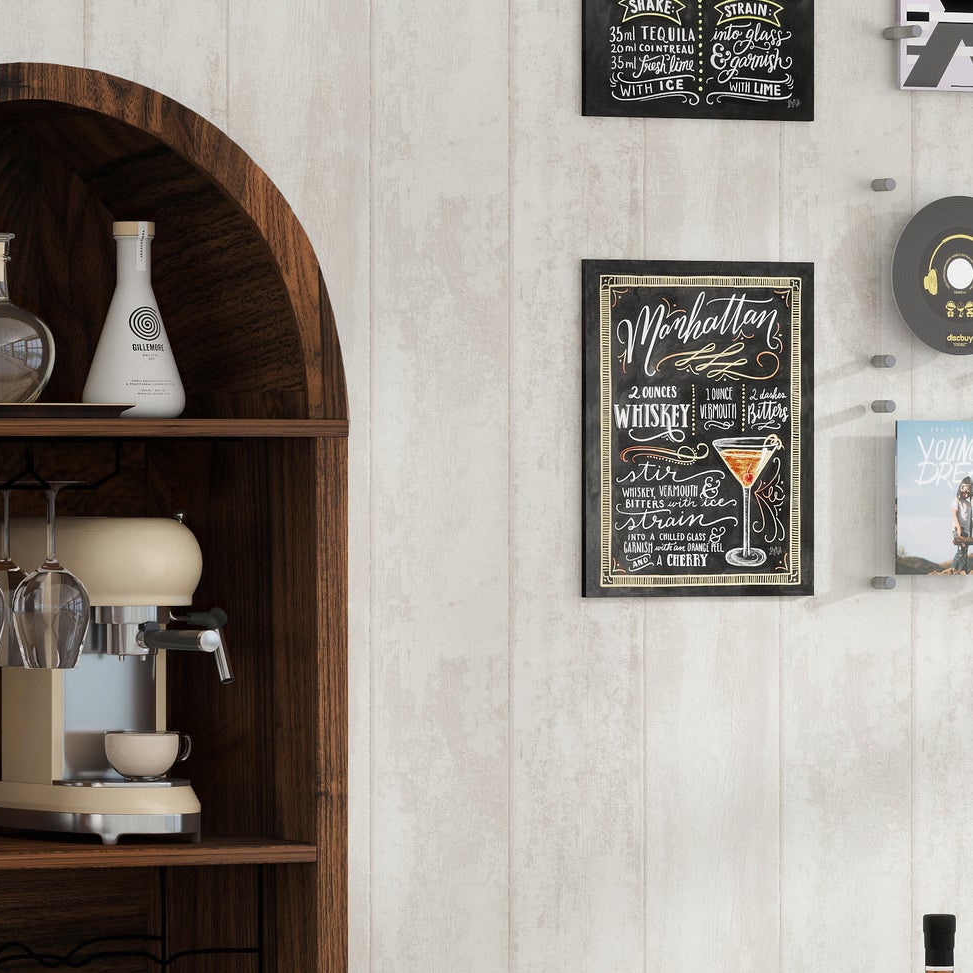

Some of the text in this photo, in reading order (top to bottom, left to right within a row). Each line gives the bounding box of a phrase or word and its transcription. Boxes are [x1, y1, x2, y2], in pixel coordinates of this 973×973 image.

[725, 3, 772, 18] STRAIN:
[640, 26, 696, 42] TEQUILA
[710, 22, 792, 47] into glass
[639, 44, 695, 54] COINTREAU
[633, 55, 671, 78] fresh
[670, 57, 695, 74] lime
[730, 49, 793, 83] garnish
[620, 79, 684, 97] WITH ICE
[729, 82, 781, 96] WITH LIME
[616, 291, 778, 376] Manhattan
[628, 386, 678, 399] 2 OUNCES
[711, 386, 734, 401] OUNCE
[749, 387, 788, 401] 2 dashes
[614, 404, 691, 431] WHISKEY
[700, 403, 738, 420] VERMOUTH
[748, 401, 789, 425] Bitters
[616, 461, 719, 483] stir
[622, 487, 656, 500] WHISKEY,
[659, 485, 698, 497] VERMOUTH
[625, 498, 735, 509] BITTERS with ice
[615, 510, 733, 531] strain
[627, 533, 646, 541] INTO
[649, 533, 656, 541] A
[659, 532, 686, 541] CHILLED
[686, 532, 707, 541] GLASS
[623, 541, 653, 554] GARNISH
[687, 543, 710, 552] ORANGE
[632, 554, 709, 568] AND A CHERRY
